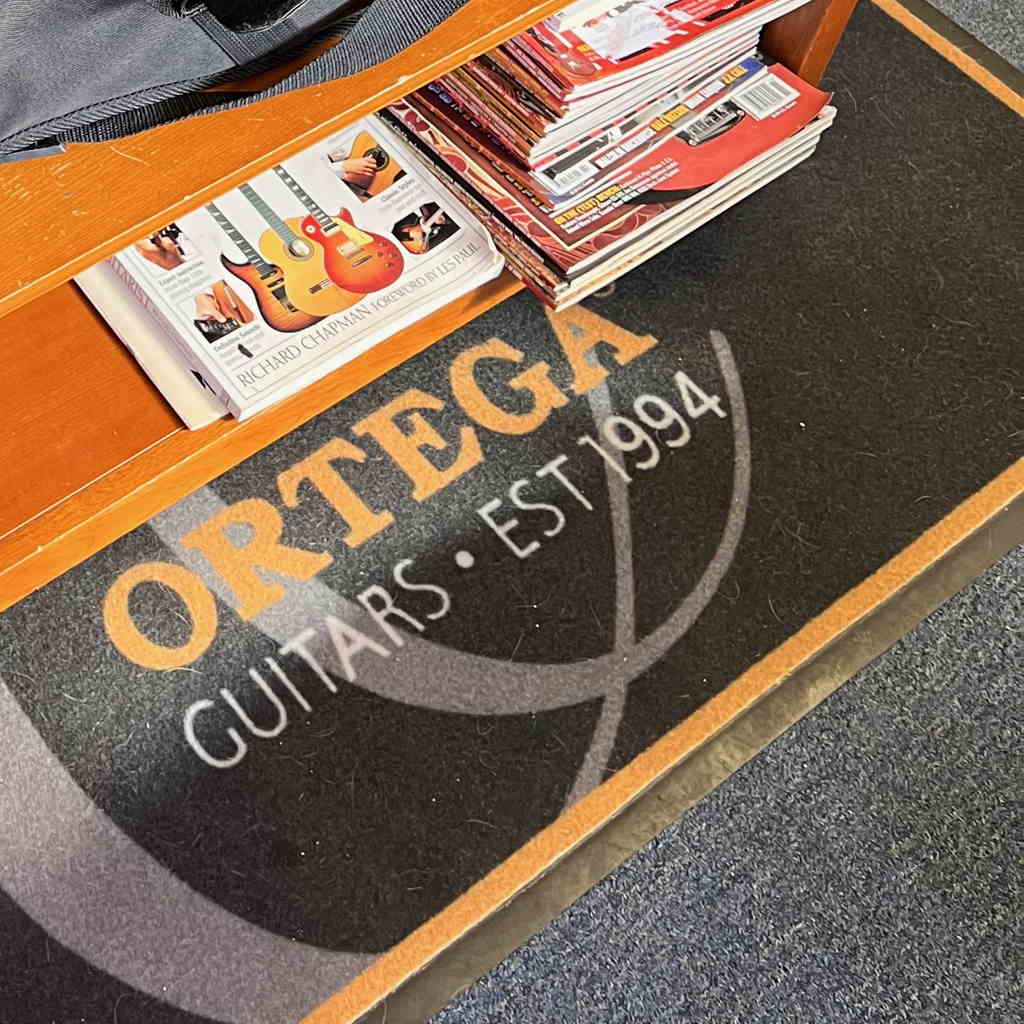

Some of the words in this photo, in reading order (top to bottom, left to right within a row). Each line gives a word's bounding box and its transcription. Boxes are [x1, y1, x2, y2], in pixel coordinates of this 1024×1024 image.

[102, 306, 659, 671] ORTEGA
[237, 344, 302, 387] RICHARD
[301, 303, 371, 350] CHAPMAN
[371, 275, 426, 311] FOREWORD
[436, 257, 455, 276] LES
[453, 241, 481, 265] PAUL
[183, 557, 451, 768] GUITARS
[478, 455, 593, 559] EST
[579, 371, 727, 485] 1994
